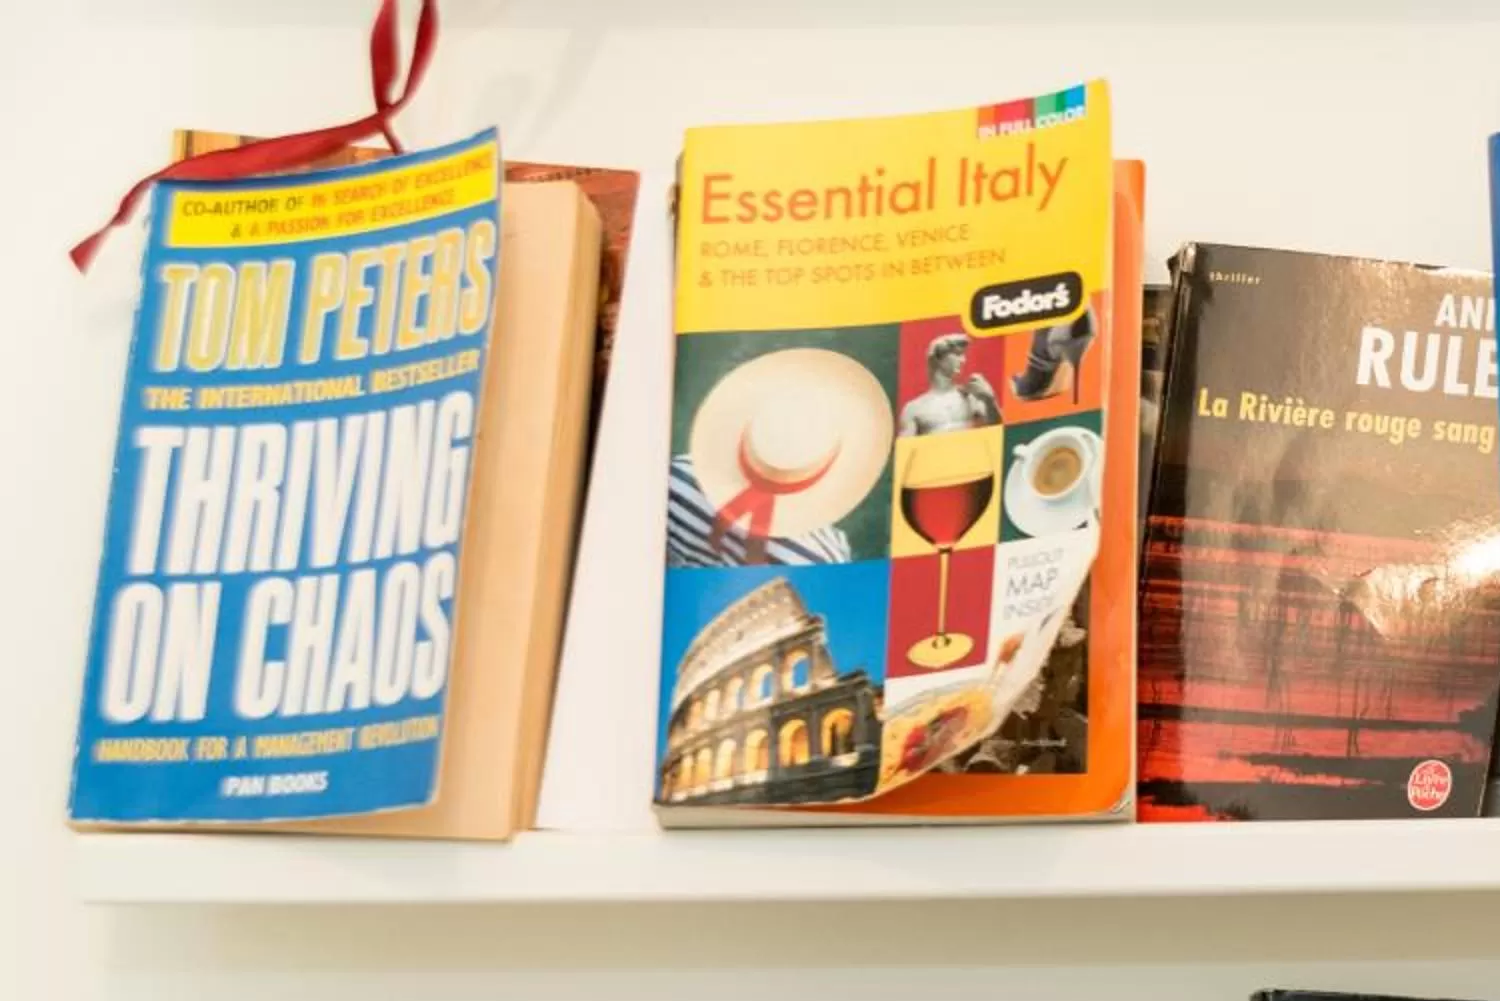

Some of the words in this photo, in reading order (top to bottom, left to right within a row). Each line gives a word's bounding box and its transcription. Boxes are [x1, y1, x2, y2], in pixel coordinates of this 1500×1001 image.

[999, 119, 1034, 137] FULL
[1036, 107, 1086, 130] COLOR
[701, 157, 936, 225] Essential
[959, 143, 1069, 212] Italy
[182, 197, 279, 217] CO-AUTHOR
[285, 195, 304, 212] OF
[699, 237, 768, 258] ROME,
[777, 232, 888, 257] FLORENCE,
[896, 223, 971, 247] VENICE
[721, 268, 757, 287] THE
[765, 267, 802, 287] TOP
[809, 263, 876, 286] SPOTS
[882, 259, 905, 278] IN
[910, 248, 1007, 276] BETWEEN
[1208, 270, 1262, 286] thriller
[154, 258, 297, 373] TOM
[297, 219, 497, 365] PETERS
[144, 386, 193, 410] THE
[195, 375, 366, 409] INTERNATIONAL
[370, 348, 482, 393] BESTSELLER
[1356, 325, 1500, 400] RULE
[1198, 388, 1229, 419] La
[1238, 391, 1335, 429] Rivière
[1345, 411, 1422, 445] rouge
[1432, 420, 1497, 454] sang
[126, 390, 474, 577] THRIVING
[1006, 568, 1059, 597] MAP
[102, 580, 224, 725] ON
[233, 551, 457, 720] CHAOS
[92, 737, 189, 762] HANDBOOK
[194, 735, 228, 761] FOR
[233, 735, 248, 758] A
[251, 727, 354, 759] MANAGEMENT
[222, 775, 266, 798] PAN
[267, 771, 329, 795] BOOKS
